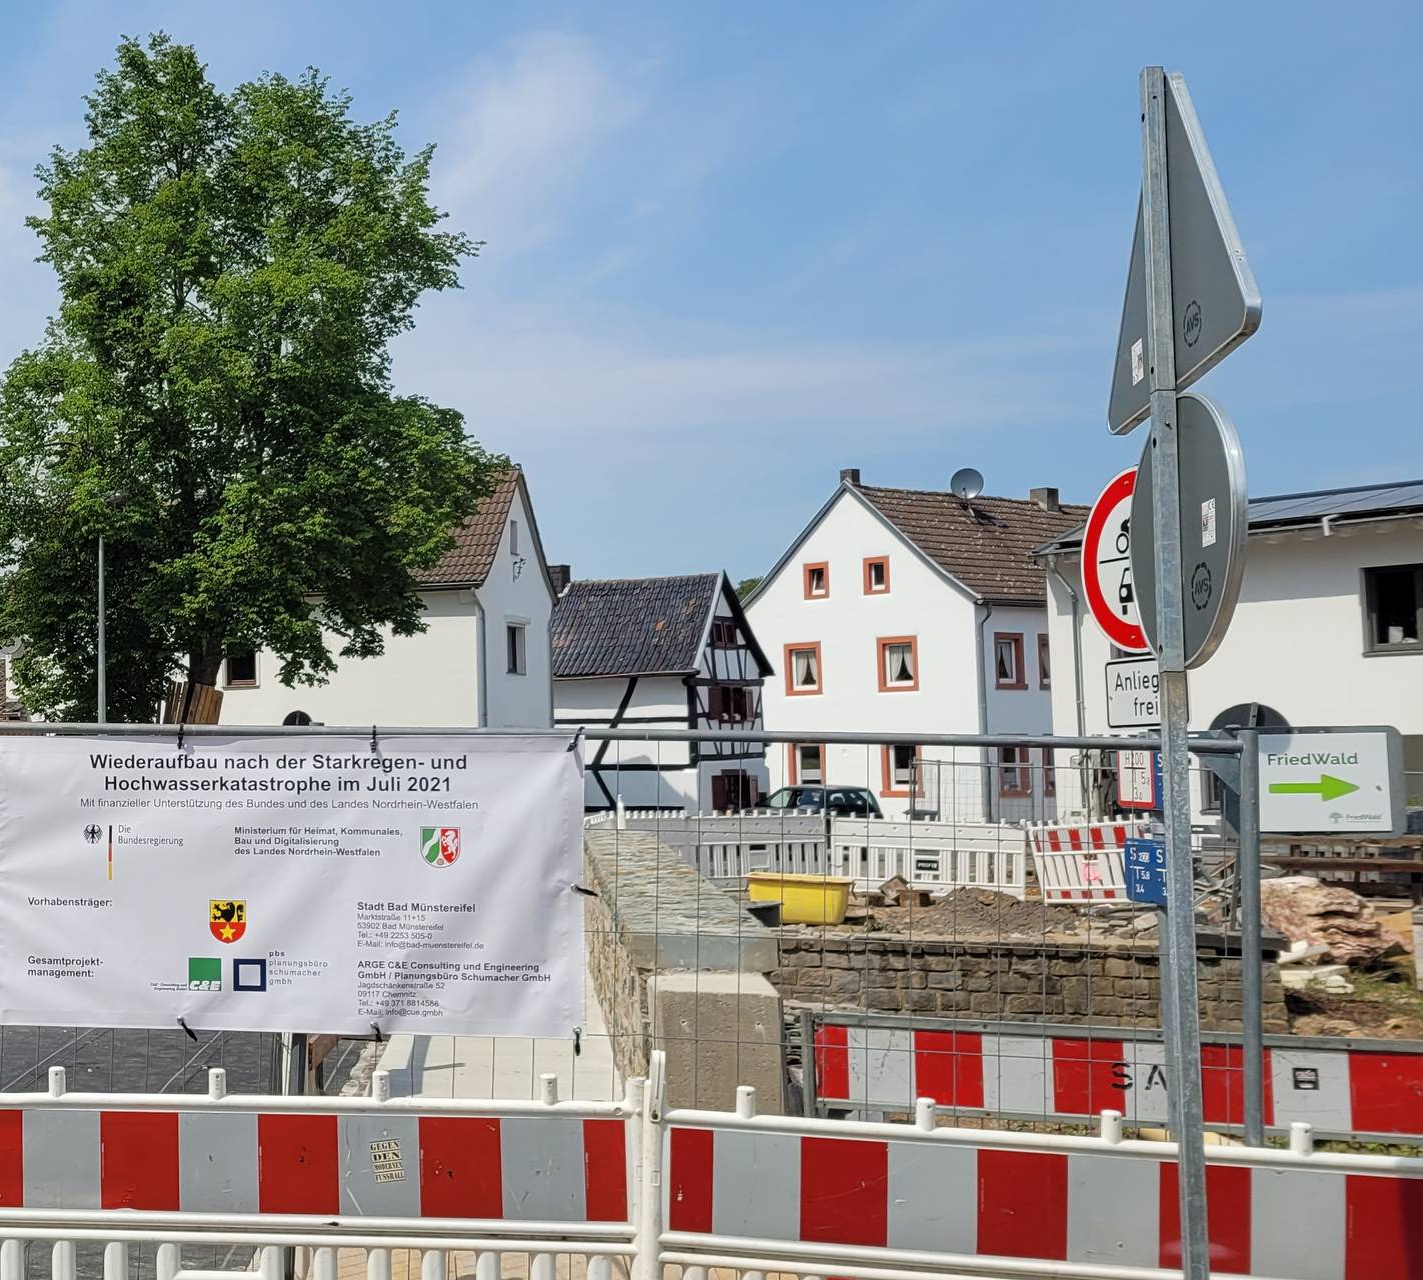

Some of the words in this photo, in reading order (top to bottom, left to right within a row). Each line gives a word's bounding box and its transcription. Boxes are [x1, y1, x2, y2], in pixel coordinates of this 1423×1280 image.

[1195, 578, 1209, 595] AVS
[1115, 670, 1160, 693] Anlieg
[1134, 696, 1158, 716] frei
[90, 754, 218, 769] Wiederaufbau
[225, 754, 269, 769] nach
[277, 754, 307, 769] der
[312, 754, 425, 773] Starkregen-
[431, 755, 467, 770] und
[1268, 752, 1358, 766] FriedWald
[105, 776, 331, 795] Hochwasserkatastrophe
[338, 777, 360, 791] im
[367, 777, 400, 792] Juli
[407, 777, 450, 792] 2021
[80, 798, 95, 808] Mit
[98, 798, 150, 808] finanzieller
[153, 798, 222, 810] Unterstützung
[225, 799, 243, 808] des
[247, 799, 284, 808] Bundes
[288, 800, 307, 809] und
[310, 800, 328, 809] des
[331, 800, 369, 809] Landes
[372, 799, 479, 810] Nordrhein-Westfalen
[118, 824, 131, 833] Die
[234, 827, 286, 835] Ministerium
[289, 827, 301, 835] für
[304, 827, 338, 836] Heimat,
[341, 827, 403, 837] Kommunales,
[118, 836, 184, 847] Bundesregierung
[234, 837, 252, 845] Bau
[255, 837, 271, 845] und
[274, 837, 339, 847] Digitalisierung
[234, 847, 250, 855] des
[253, 847, 285, 855] Landes
[288, 848, 381, 856] Nordrhein-Westfalen
[1156, 849, 1164, 864] S
[28, 896, 113, 908] Vorhabensträger:
[357, 902, 384, 911] Stadt
[387, 903, 408, 911] Bad
[411, 903, 476, 913] Münstereifel
[357, 922, 380, 930] 53902
[399, 923, 444, 931] Münstereifel
[391, 931, 409, 939] 2253
[411, 932, 432, 940] 505-0
[357, 940, 383, 948] E-Mail:
[385, 940, 484, 950] info@bad-muenstereifel.de
[269, 950, 285, 959] pbs
[28, 955, 103, 967] Gesamtprojekt-
[269, 959, 328, 968] planungsbüro
[357, 961, 385, 969] ARGE
[387, 961, 408, 969] C&E
[410, 961, 460, 971] Consulting
[463, 963, 481, 971] und
[484, 963, 539, 973] Engineering
[28, 969, 94, 979] management:
[269, 969, 321, 977] schumacher
[358, 971, 386, 979] GmbH
[394, 972, 459, 982] Planungsbüro
[461, 973, 519, 982] Schumacher
[522, 973, 551, 982] GmbH
[190, 980, 222, 991] C&E
[269, 978, 292, 986] gmbh
[435, 982, 445, 990] 52
[357, 990, 380, 998] 09117
[382, 990, 417, 998] Chemnitz
[375, 999, 389, 1007] +49
[391, 999, 404, 1007] 371
[357, 1008, 384, 1016] E-Mail:
[385, 1008, 443, 1017] info@cue.gmbh
[370, 1141, 399, 1150] GEGEN
[373, 1152, 400, 1161] DEN
